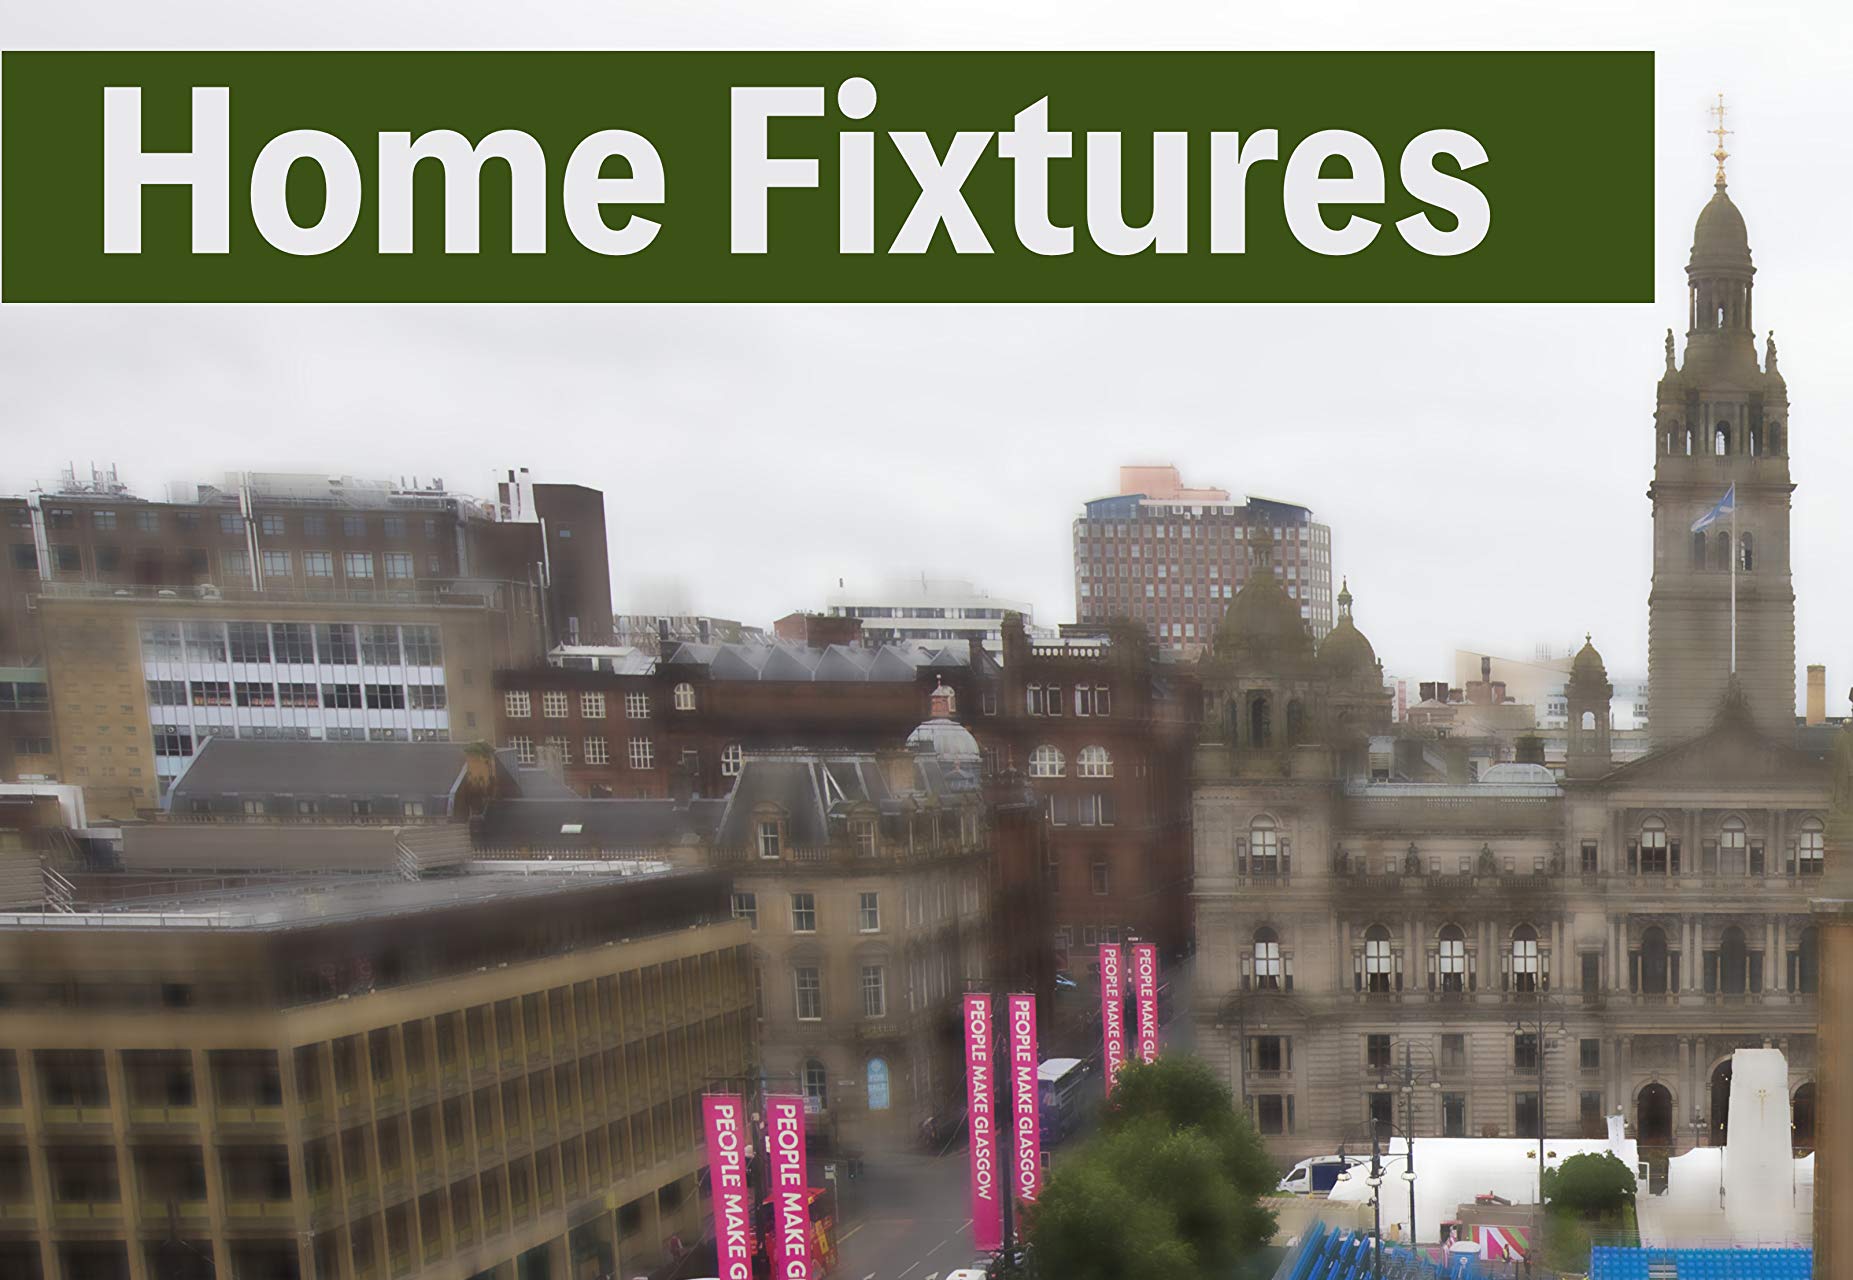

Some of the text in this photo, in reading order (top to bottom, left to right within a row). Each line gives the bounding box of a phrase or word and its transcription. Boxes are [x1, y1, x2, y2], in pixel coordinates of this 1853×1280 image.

[1105, 949, 1119, 997] PEOPLE
[1139, 949, 1155, 1066] PEOPLE MAKE GLA
[1107, 1000, 1120, 1038] MAKE
[970, 1001, 992, 1200] PEOPLE MAKE GLASGOW
[1015, 1001, 1036, 1201] PEOPLE MAKE GLASGOW
[714, 1105, 742, 1186] PEOPLE
[777, 1104, 801, 1186] PEOPLE
[724, 1194, 747, 1258] MAKE
[782, 1192, 805, 1256] MAKE
